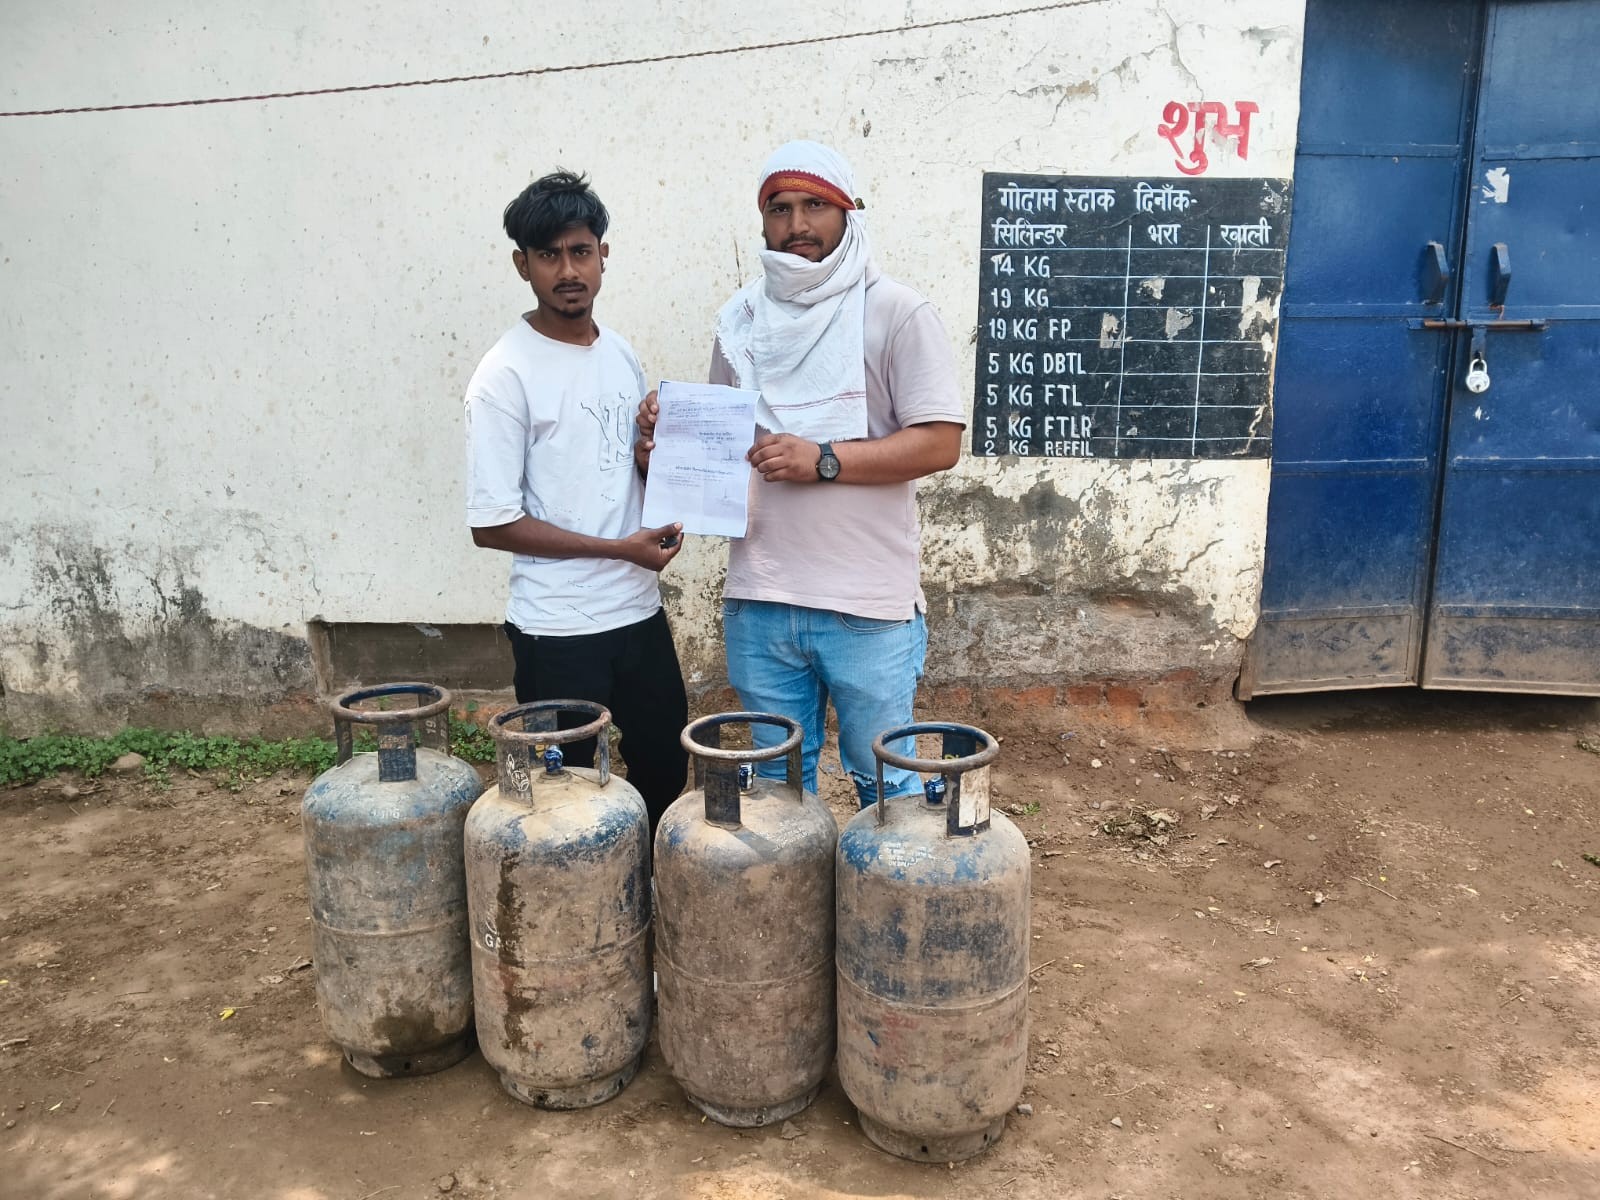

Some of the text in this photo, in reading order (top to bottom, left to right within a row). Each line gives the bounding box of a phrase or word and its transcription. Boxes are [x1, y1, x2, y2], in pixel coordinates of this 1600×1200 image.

[998, 182, 1059, 214] गोदाम
[1148, 224, 1181, 245] भरा
[1220, 216, 1272, 247] खाली
[991, 254, 1050, 278] 14 KG
[991, 288, 1049, 308] 19 KG
[989, 318, 1072, 340] 19 KG FP
[988, 352, 1087, 375] 5 KG DBTL
[987, 384, 1083, 407] 5 KG FTL
[986, 415, 1093, 438] 5 KG FTLR
[984, 440, 1094, 456] 2 KG REFFIL
